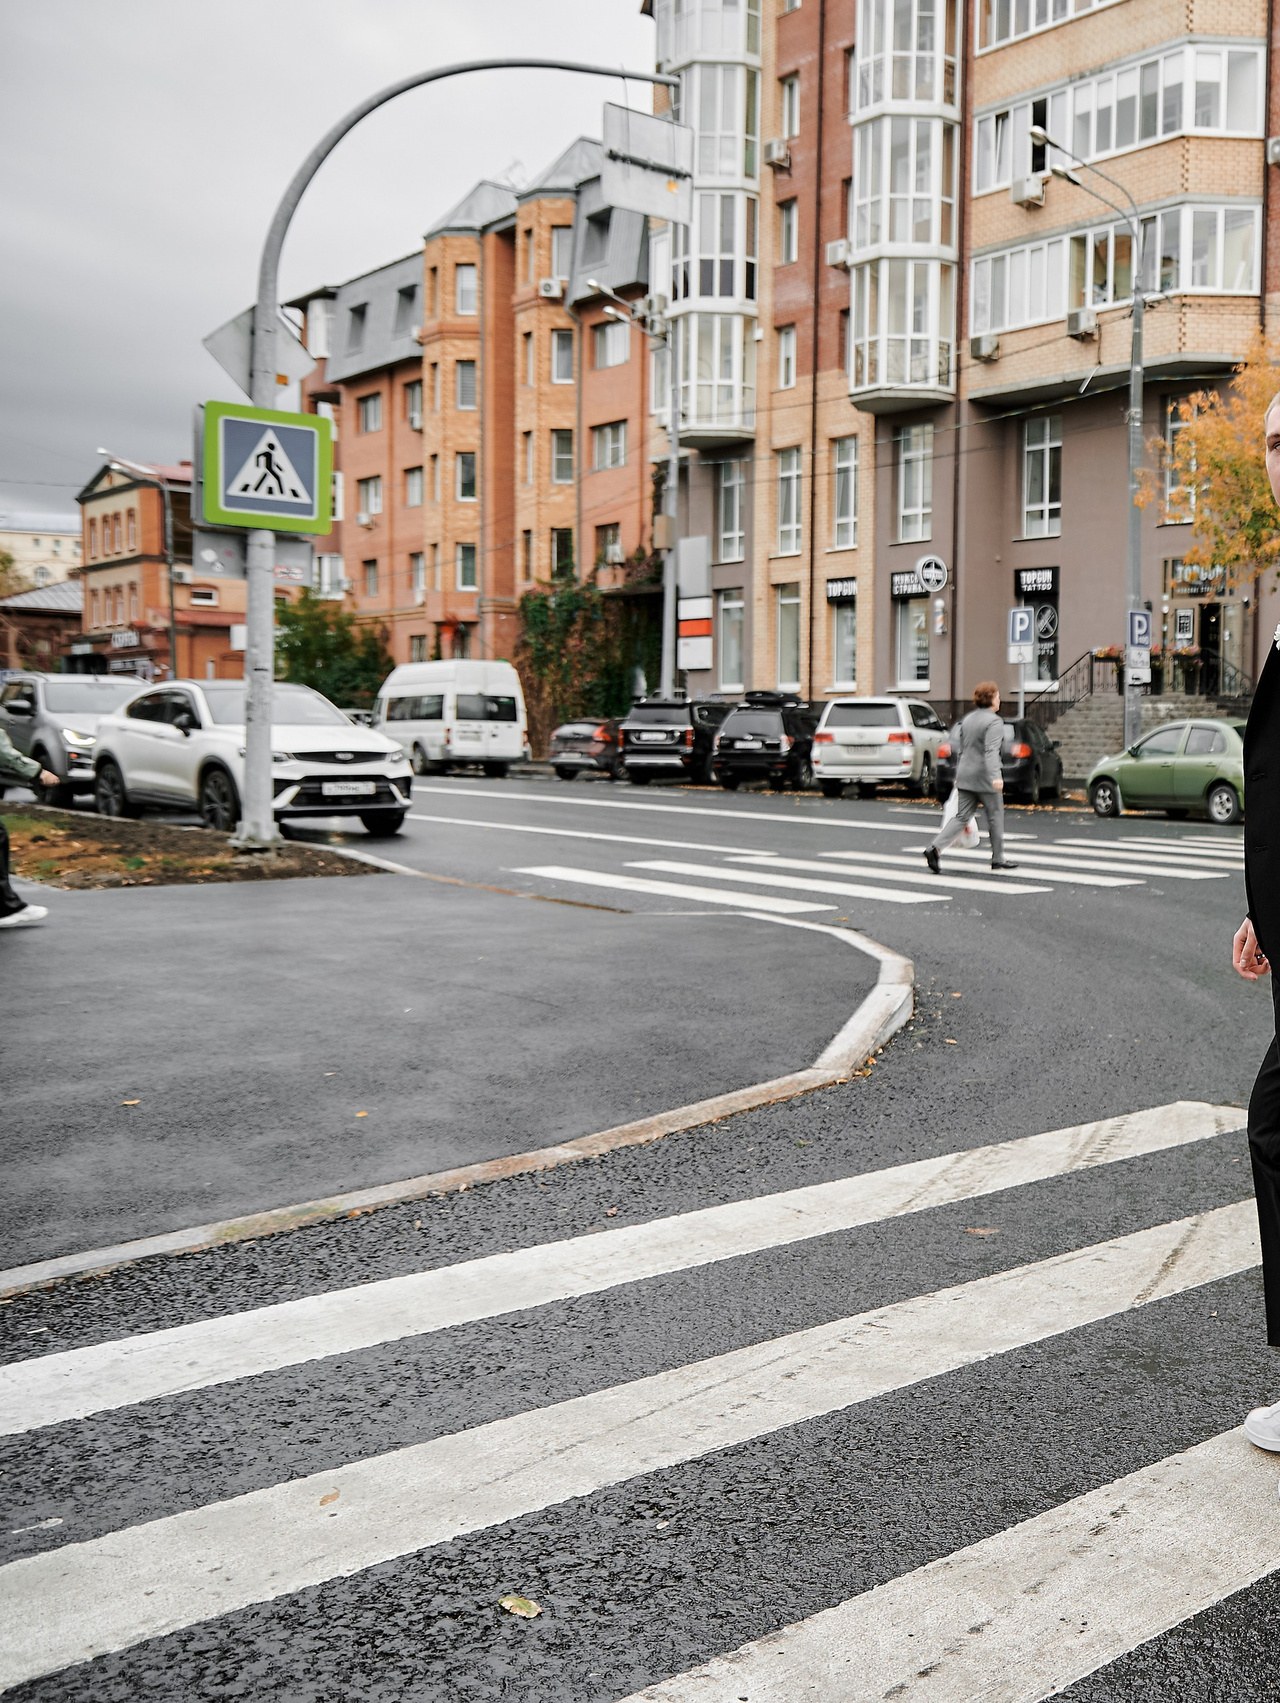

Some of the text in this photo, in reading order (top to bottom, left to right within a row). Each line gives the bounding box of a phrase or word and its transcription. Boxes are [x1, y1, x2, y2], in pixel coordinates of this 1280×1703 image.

[1020, 569, 1053, 584] TOPGUN
[827, 580, 858, 598] TOPGUN
[1022, 582, 1053, 592] TATTOO
[1015, 611, 1030, 641] P
